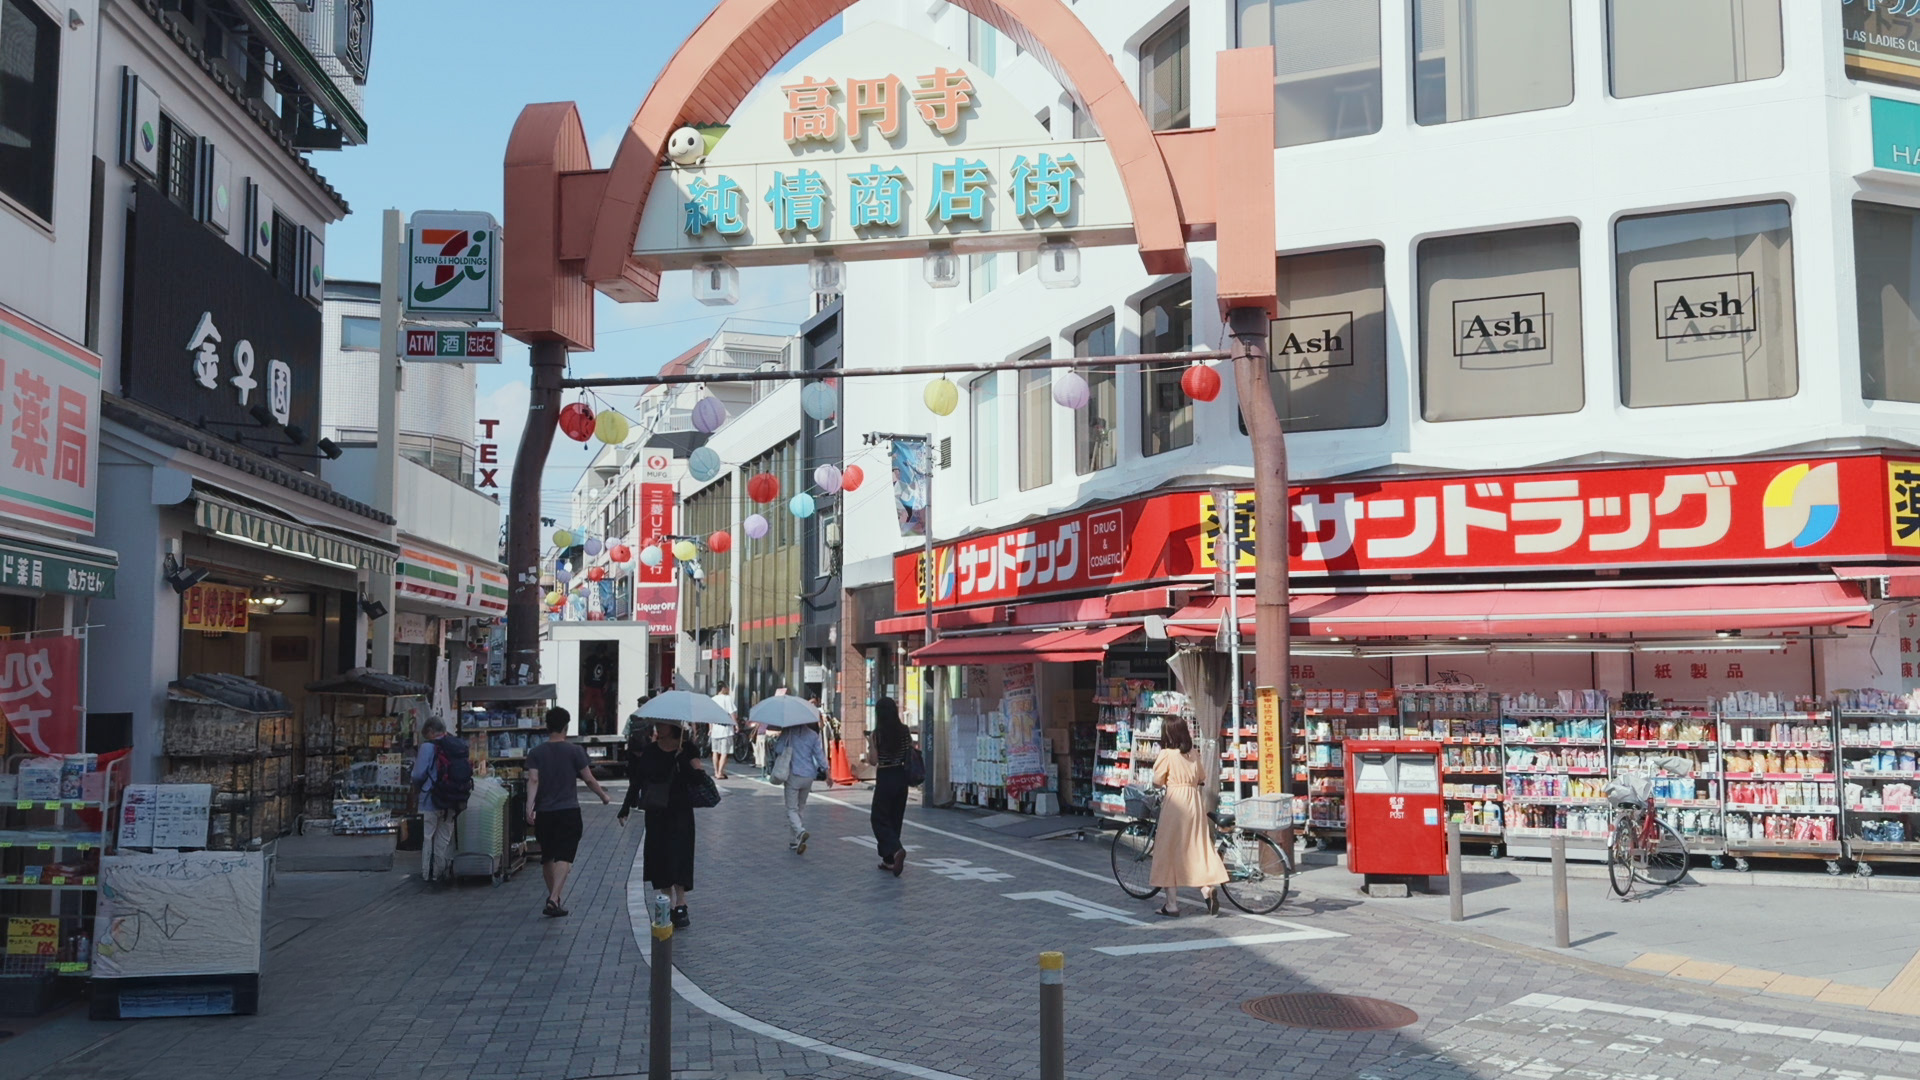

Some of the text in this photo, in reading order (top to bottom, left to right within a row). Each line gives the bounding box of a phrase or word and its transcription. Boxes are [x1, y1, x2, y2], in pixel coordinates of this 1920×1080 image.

[1843, 28, 1867, 43] LAS
[1869, 33, 1905, 50] LADIES
[781, 67, 974, 143] 高円寺
[683, 152, 1077, 236] 純情商店街
[448, 256, 488, 266] HOLDINGS
[1667, 290, 1744, 321] Ash
[1463, 312, 1536, 339] Ash
[409, 335, 494, 352] ATM 酒 たばこ
[1279, 329, 1344, 356] Ash
[1093, 520, 1116, 535] DRUG
[1292, 470, 1738, 562] サンドラッグ
[1102, 538, 1108, 550] &
[959, 521, 1081, 596] サンドラッグ
[1090, 552, 1121, 568] COSMETIC
[67, 567, 104, 592] 処方せん
[184, 586, 247, 627] 日特売日
[1654, 663, 1744, 679] 紙製品
[1389, 811, 1405, 820] POST
[31, 922, 57, 937] 235
